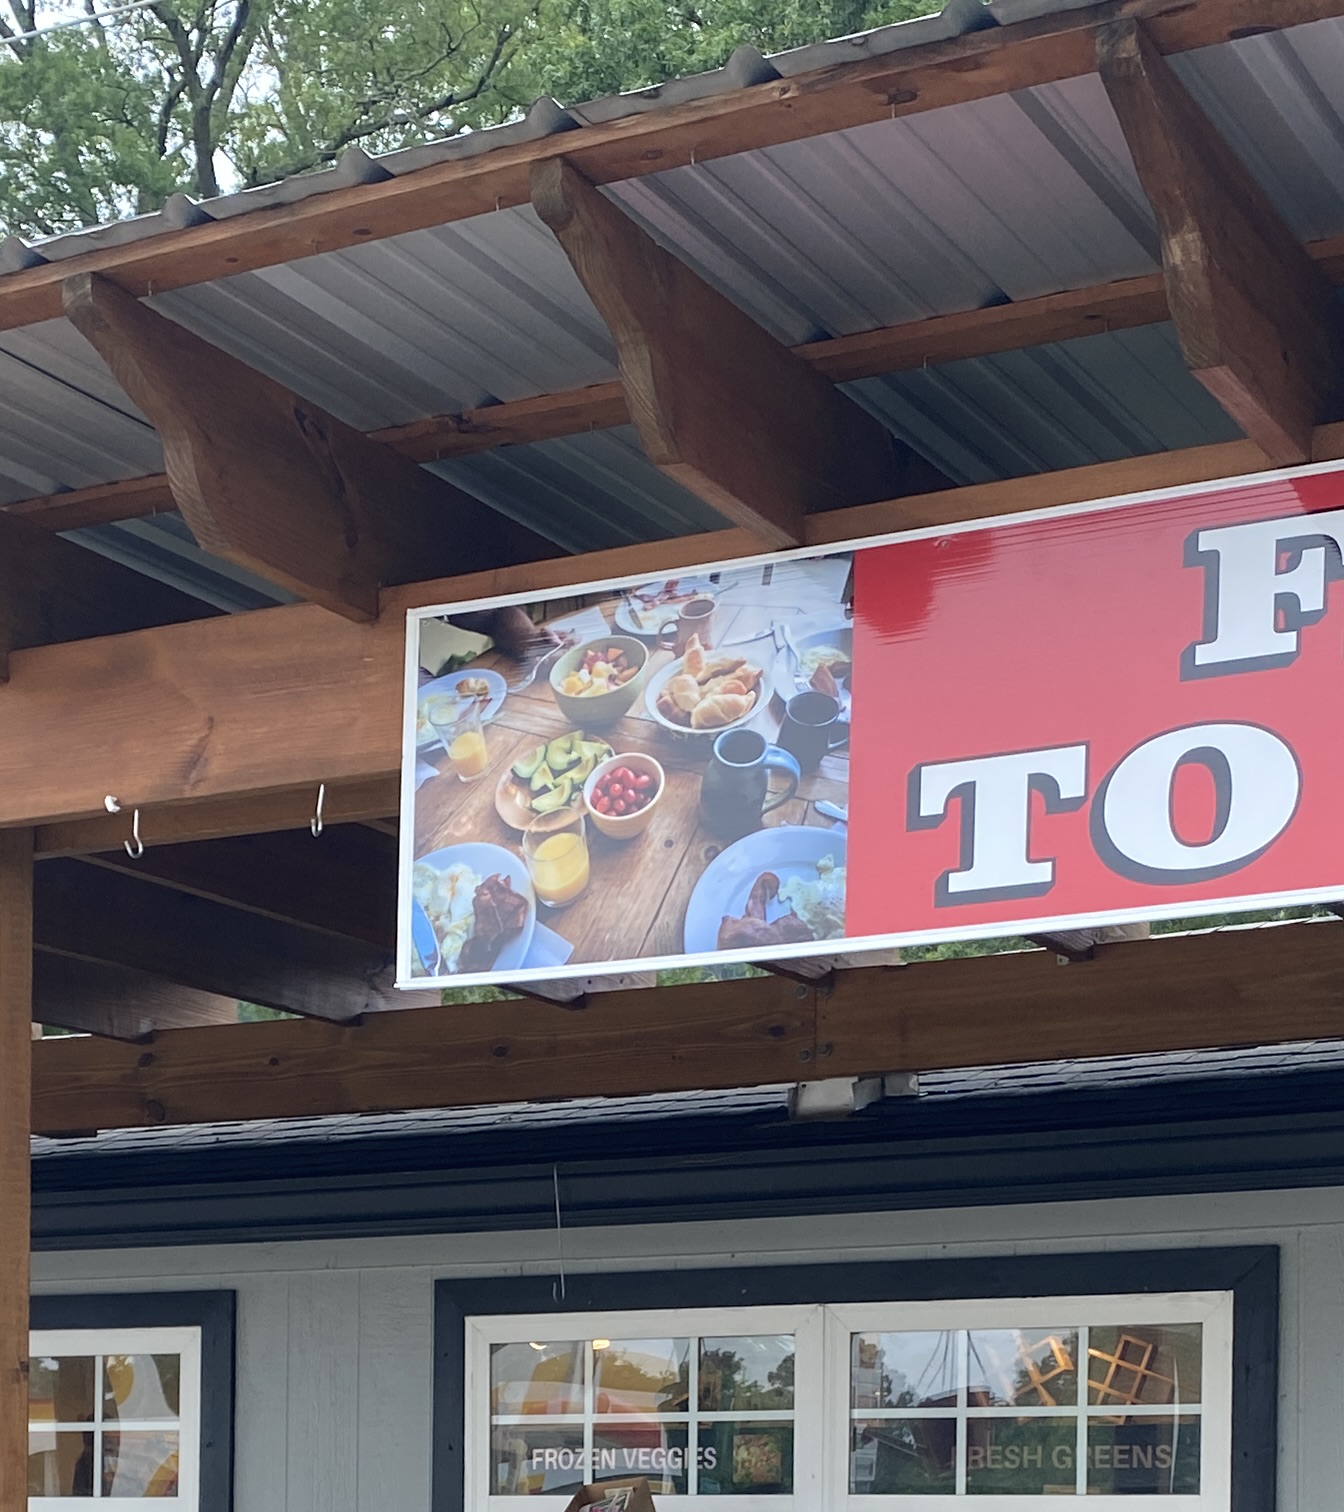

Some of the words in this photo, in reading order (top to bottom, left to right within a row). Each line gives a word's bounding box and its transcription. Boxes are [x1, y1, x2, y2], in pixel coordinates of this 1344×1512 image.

[904, 721, 1302, 906] TO
[532, 1448, 616, 1470] FROZEN
[623, 1447, 718, 1470] VEGGIES
